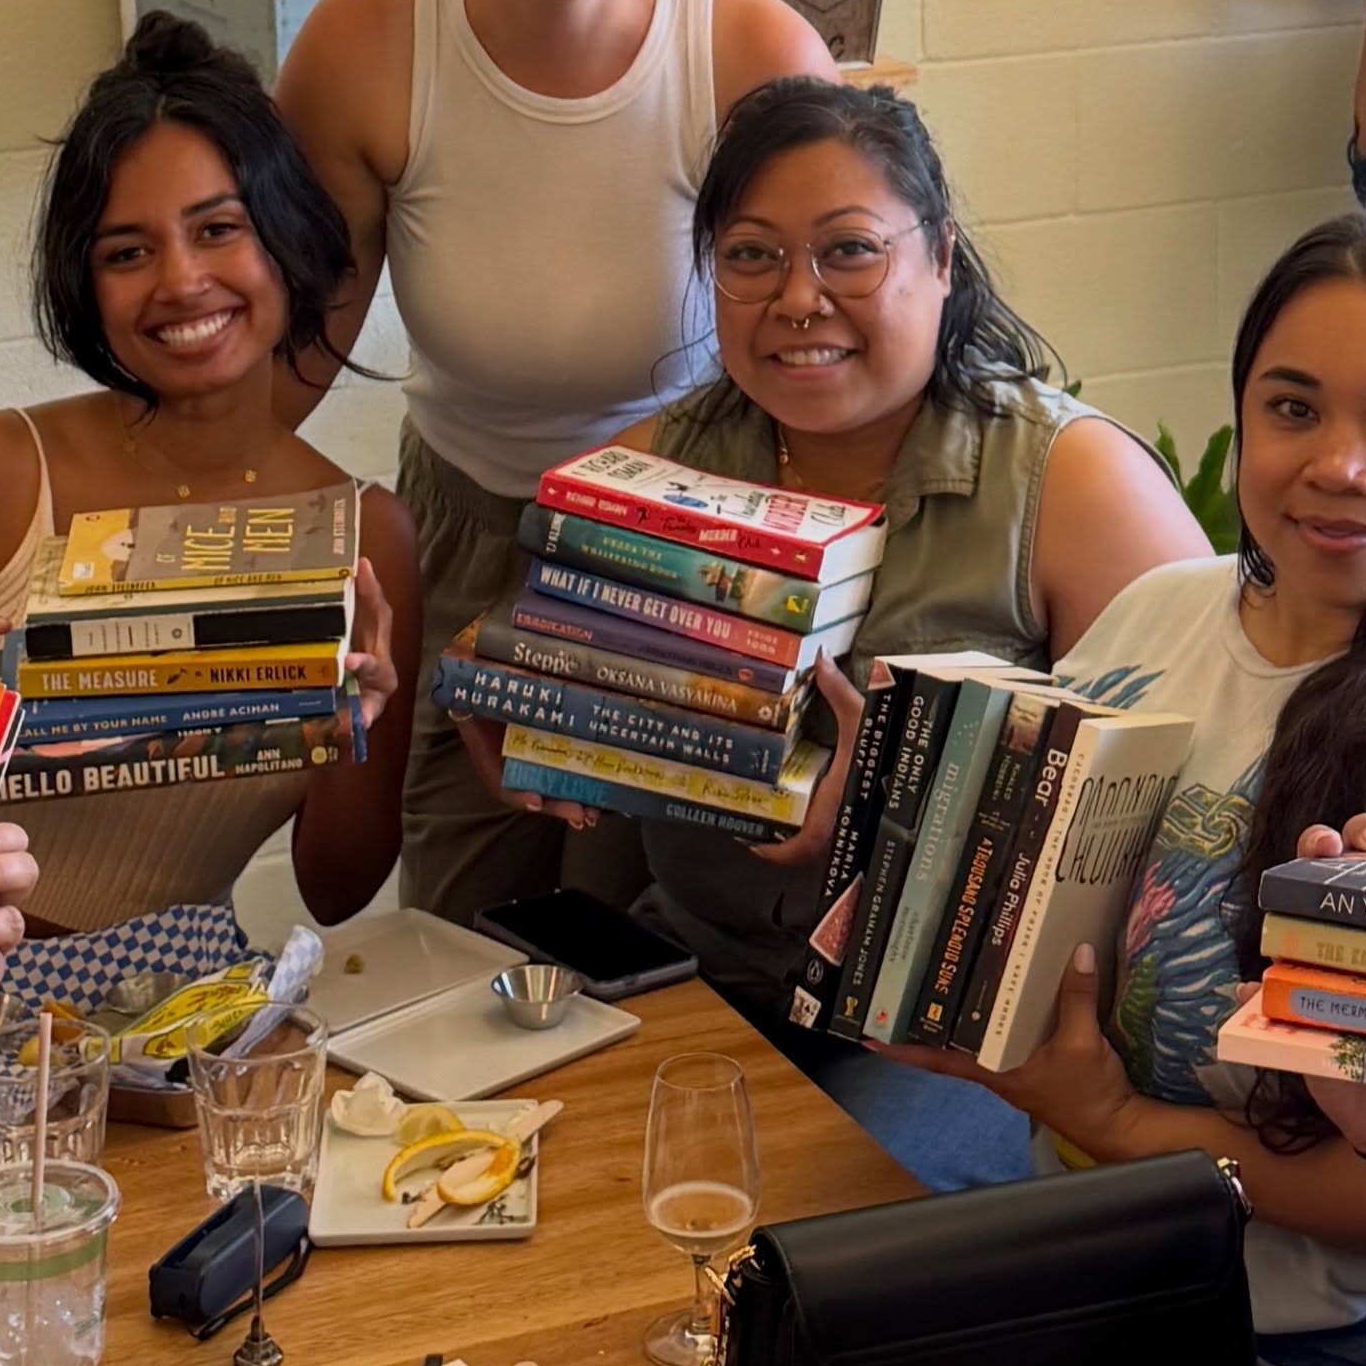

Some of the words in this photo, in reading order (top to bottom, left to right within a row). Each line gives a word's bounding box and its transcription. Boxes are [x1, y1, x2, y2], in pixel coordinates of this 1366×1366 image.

[181, 524, 235, 570] MICE
[243, 508, 295, 552] MEN
[540, 565, 575, 590] WHAT
[577, 576, 592, 595] IF
[593, 580, 600, 598] I
[601, 581, 640, 612] NEVER
[643, 597, 668, 619] GET
[669, 605, 703, 631] OVER
[706, 617, 732, 639] YOU
[42, 672, 71, 691] THE
[77, 669, 158, 691] MEASURE
[210, 667, 250, 683] NIKKI
[256, 665, 307, 682] ERLICK
[475, 671, 562, 704] HARUKI
[514, 643, 577, 675] Steppe
[597, 667, 654, 693] OKSANA
[660, 680, 737, 711] VASYAKINA
[51, 725, 70, 736] ME
[73, 723, 89, 733] BY
[92, 719, 127, 731] YOUR
[131, 715, 168, 727] NAME
[229, 703, 280, 717] ACIMAN
[454, 687, 574, 727] MURAKAMI
[592, 705, 621, 722] THE
[627, 714, 665, 732] CITY
[671, 724, 700, 741] AND
[708, 733, 734, 749] ITS
[877, 694, 891, 724] THE
[905, 696, 924, 740] GOOD
[589, 720, 675, 750] UNCERTAIN
[683, 742, 730, 764] WALLS
[856, 718, 873, 769] BLUFF
[918, 719, 934, 748] THE
[83, 754, 225, 792] BEAUTIFUL
[859, 730, 884, 801] BIGGEST
[888, 747, 912, 809] INDIANS
[907, 754, 925, 795] ONLY
[1036, 748, 1068, 807] Bear
[825, 804, 852, 897] KONNIKOVA
[841, 831, 860, 880] MARIA
[982, 838, 993, 846] A
[876, 840, 896, 893] STEPHEN
[962, 845, 994, 904] THOUSAND
[1009, 852, 1031, 889] Julia
[991, 891, 1020, 946] Phillips
[1319, 892, 1354, 914] AN
[944, 904, 975, 962] SPLENDID
[1316, 942, 1344, 963] THE
[852, 947, 870, 985] JONES
[935, 962, 957, 995] SUNS
[1299, 996, 1325, 1013] THE
